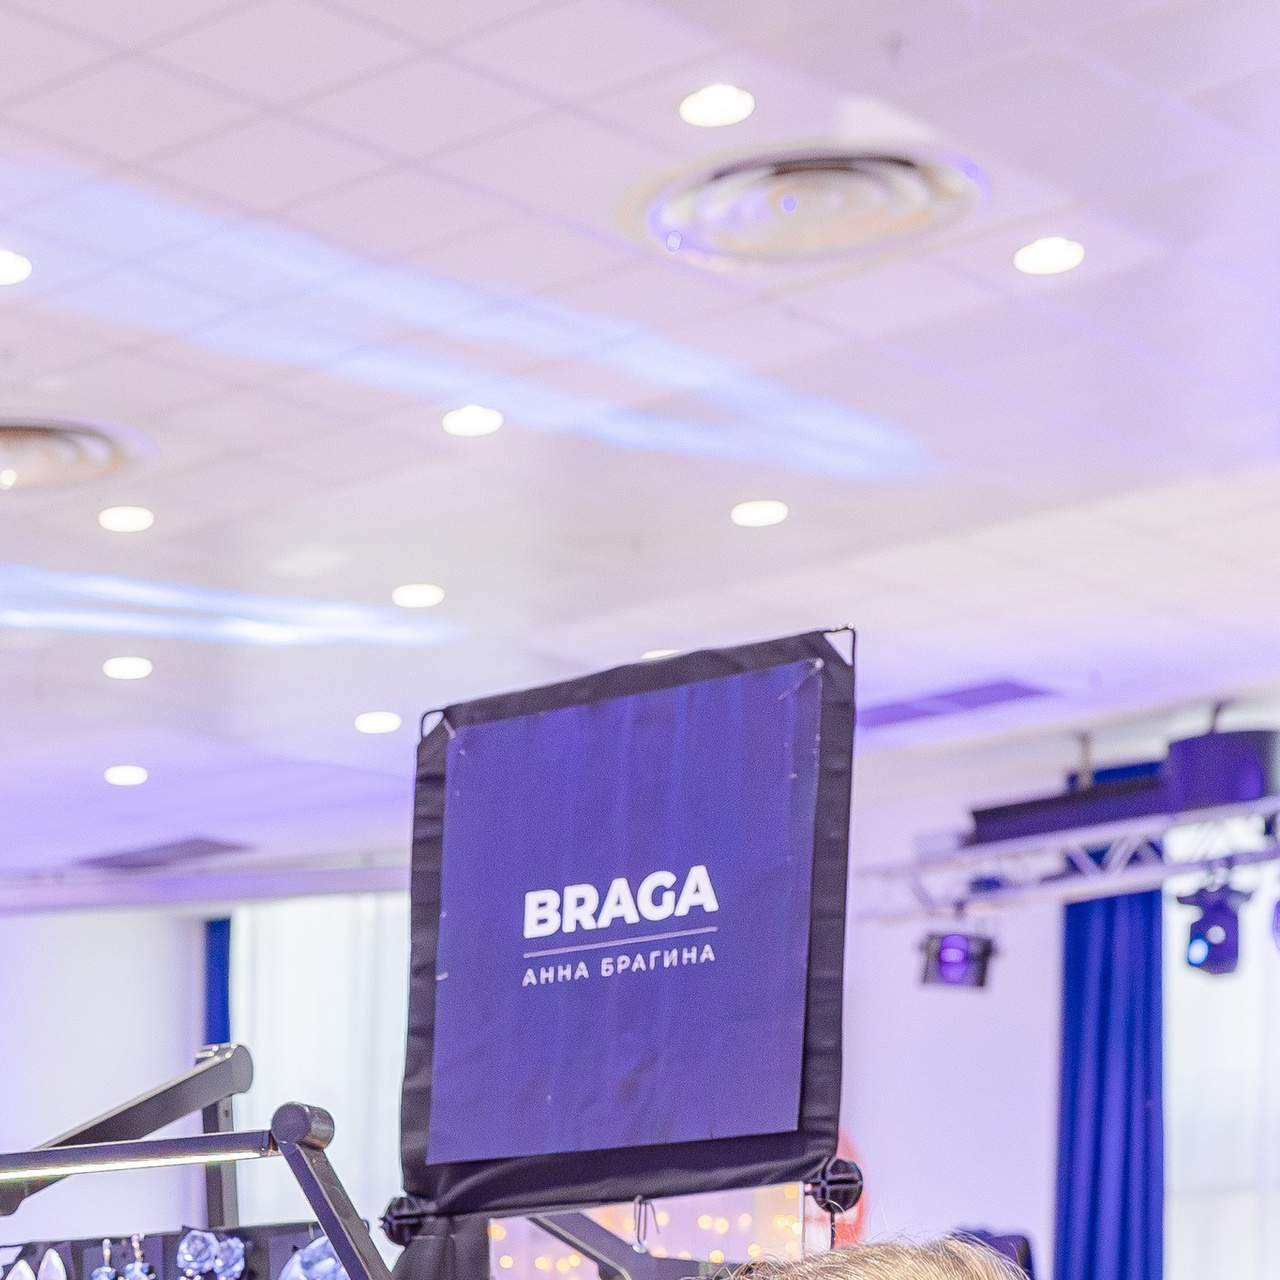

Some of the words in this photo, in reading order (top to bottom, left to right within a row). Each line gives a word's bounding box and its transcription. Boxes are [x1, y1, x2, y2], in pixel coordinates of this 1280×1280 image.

[523, 864, 720, 939] BRAGA
[522, 961, 590, 987] АННА
[600, 944, 716, 977] БРАГИНА
